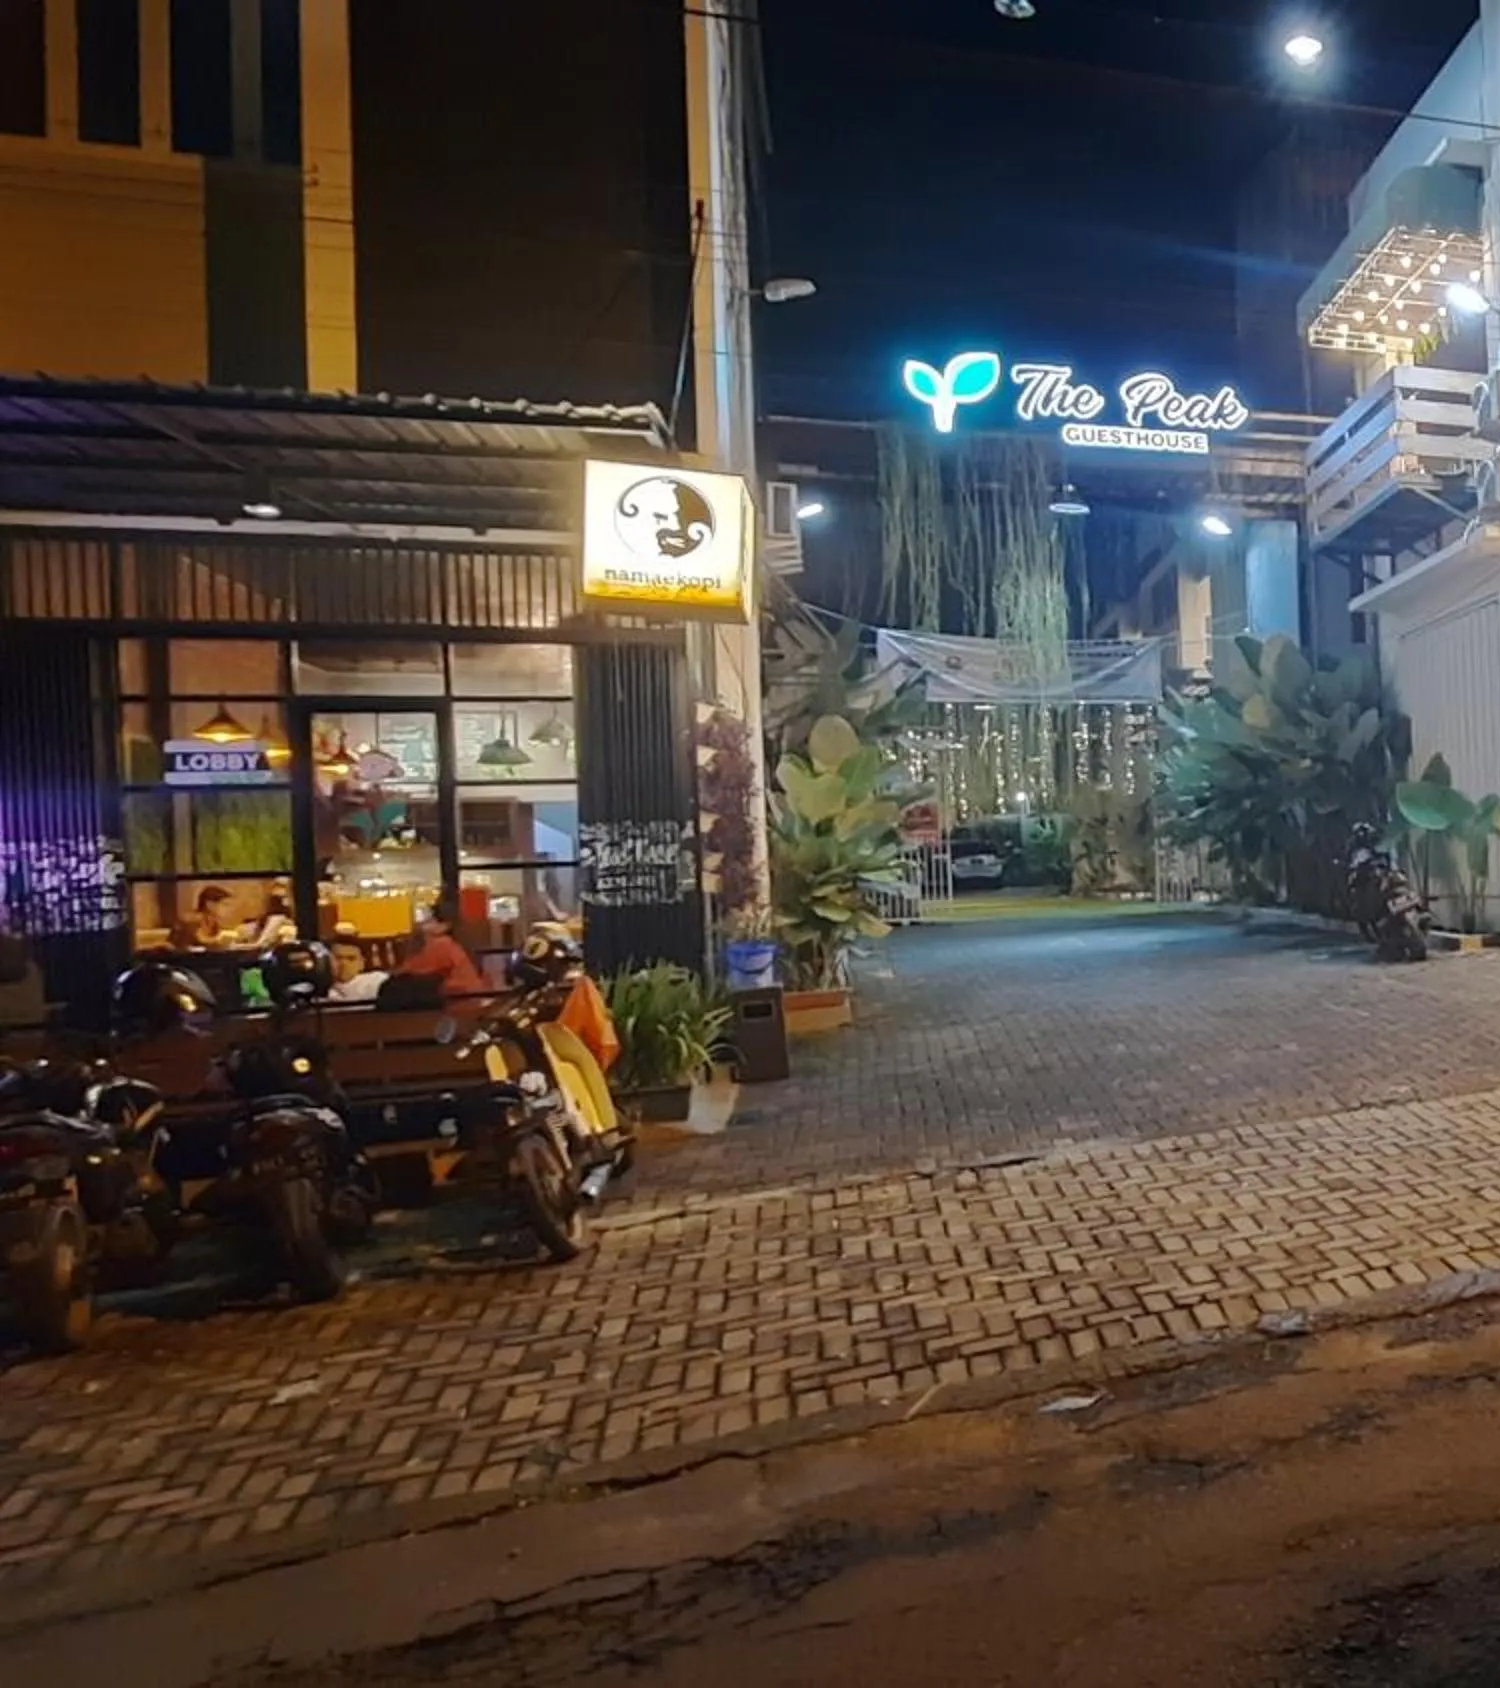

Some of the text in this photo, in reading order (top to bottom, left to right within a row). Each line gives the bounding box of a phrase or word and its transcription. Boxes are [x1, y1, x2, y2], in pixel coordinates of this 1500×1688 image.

[1011, 363, 1248, 429] The Peak
[1064, 426, 1208, 452] GUESTHOUSE
[174, 752, 260, 771] LOBBY
